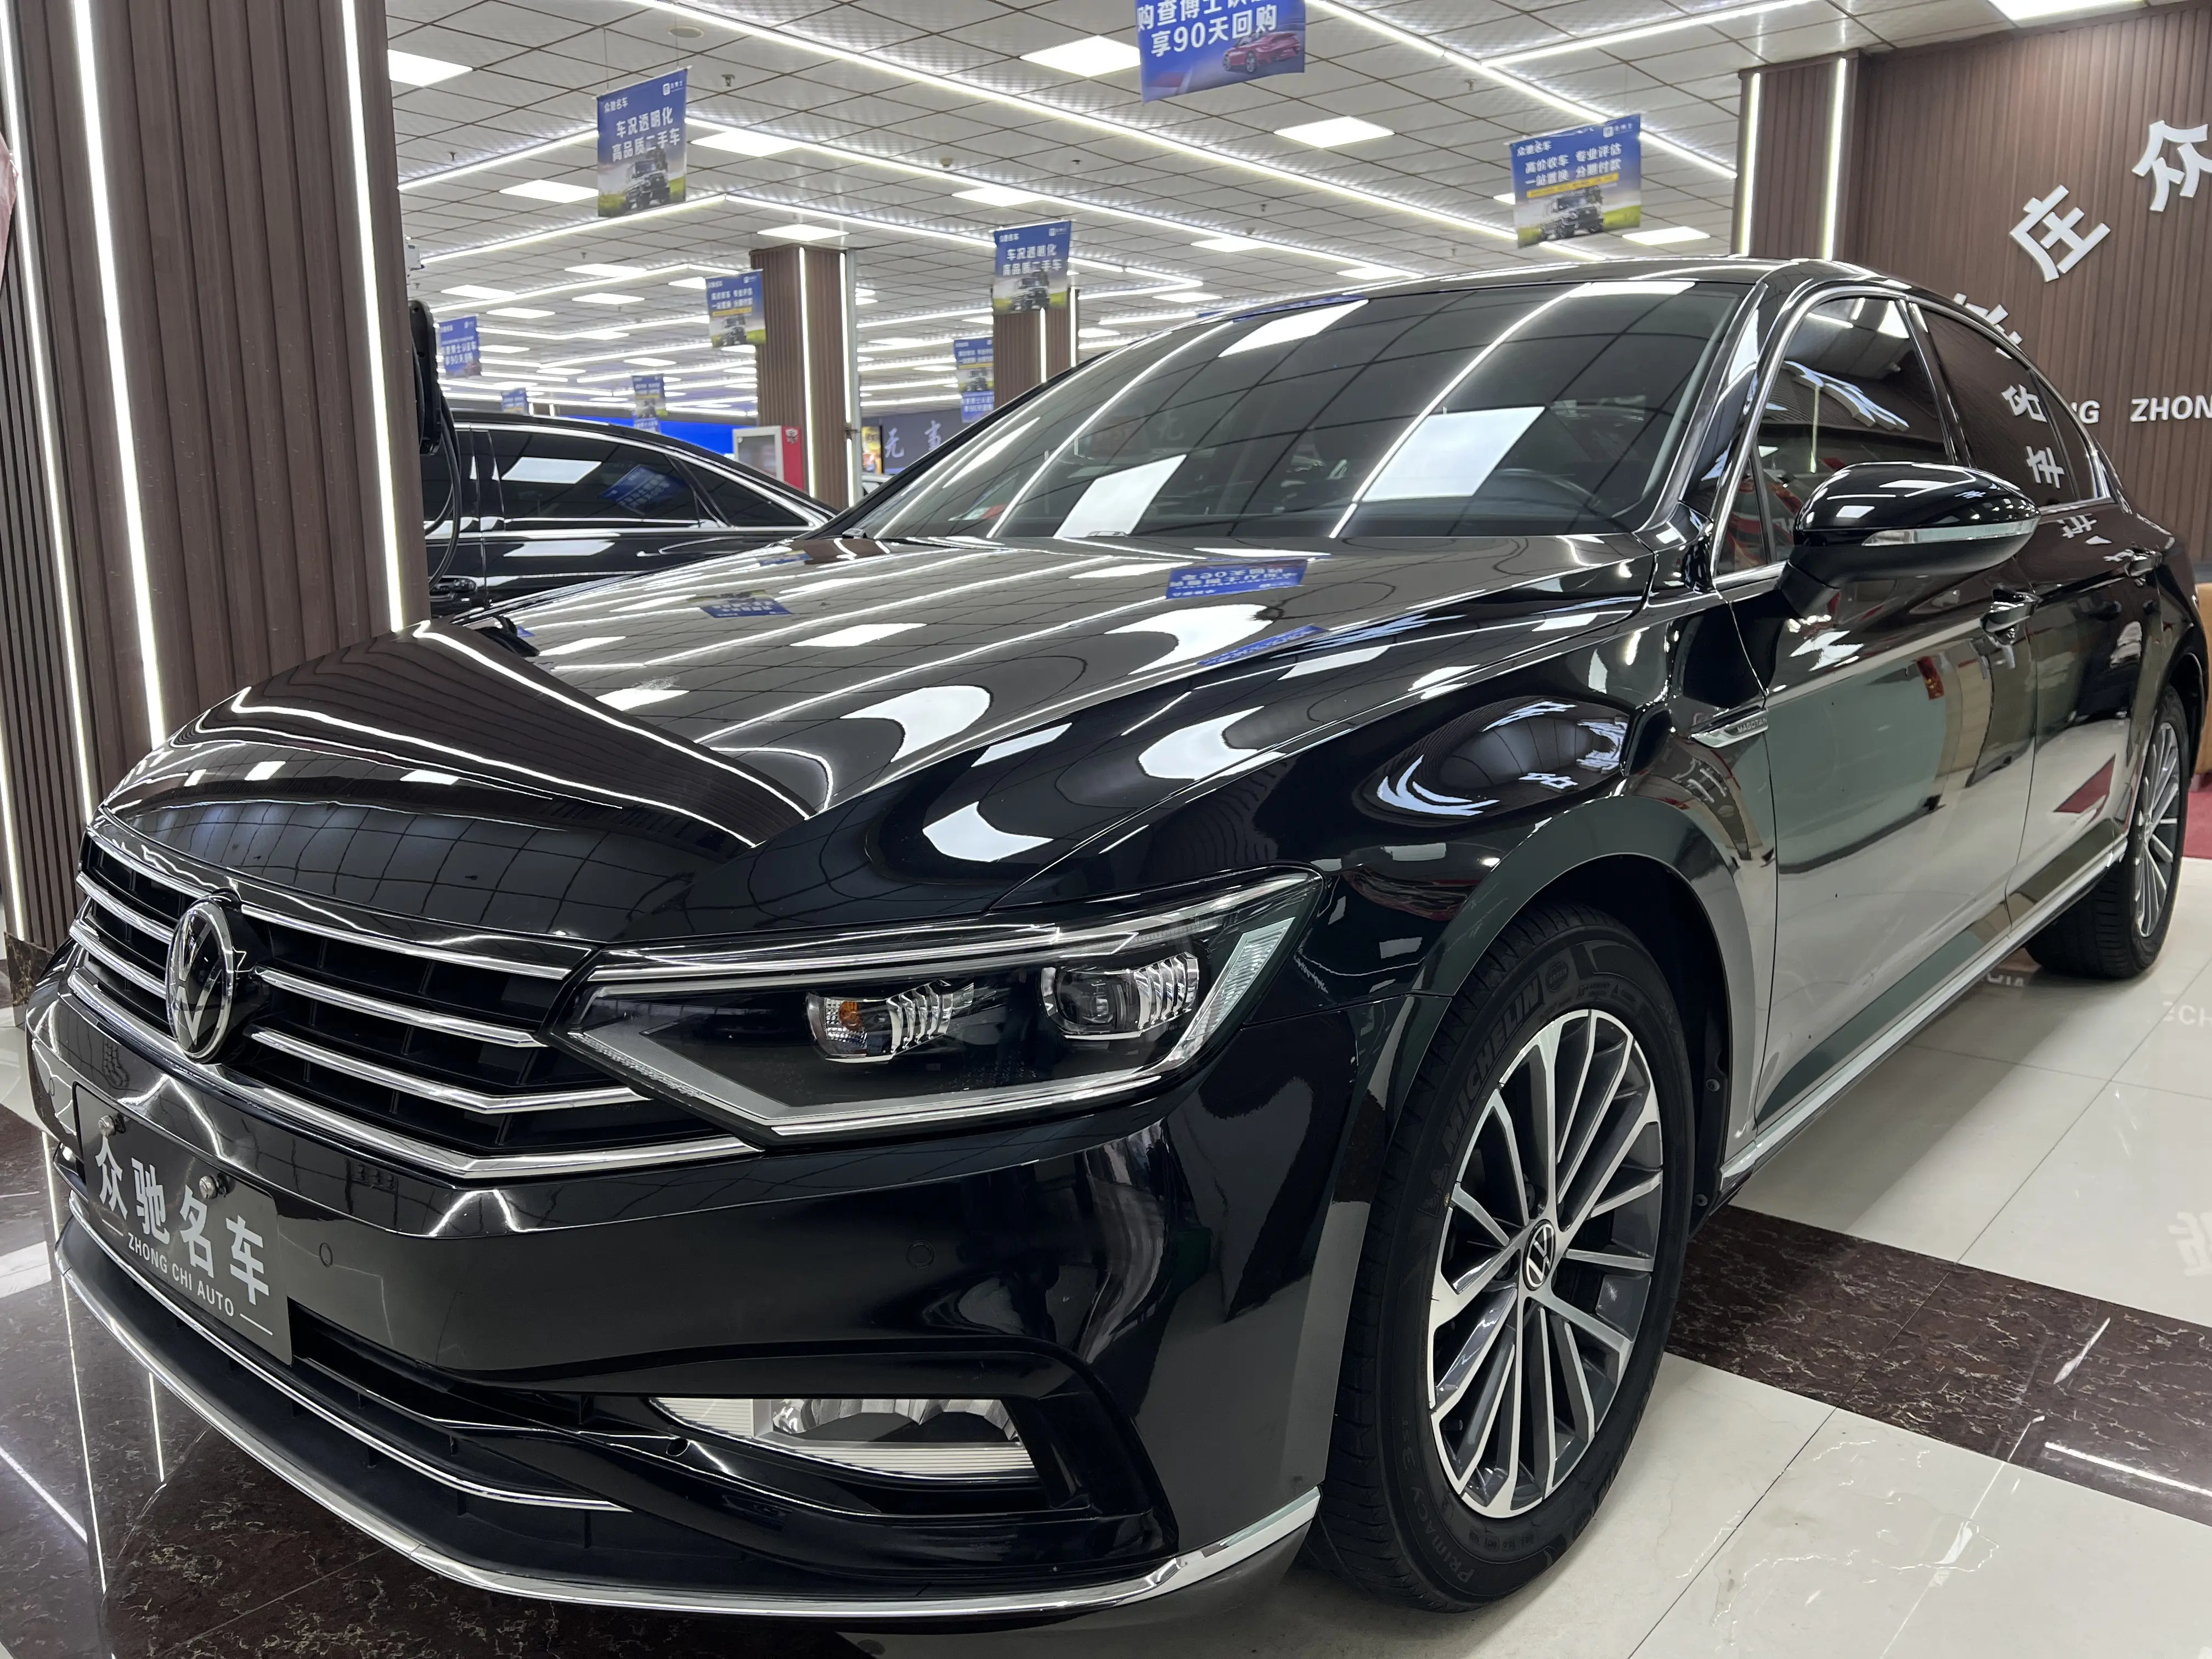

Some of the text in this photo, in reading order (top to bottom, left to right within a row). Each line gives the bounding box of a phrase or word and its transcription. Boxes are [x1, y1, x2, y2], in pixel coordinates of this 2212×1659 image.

[1137, 0, 1261, 32] 购查博士
[1151, 4, 1277, 57] 享90天回购
[616, 106, 674, 138] 车况透明化
[612, 128, 680, 162] 高品质二手车
[2130, 394, 2212, 422] ZHON
[1737, 717, 1768, 733] MAGOTAN
[1442, 975, 1543, 1155] MICHELIN
[95, 1136, 269, 1305] 众驰名车
[128, 1232, 234, 1316] ZHONG CHI AUTO
